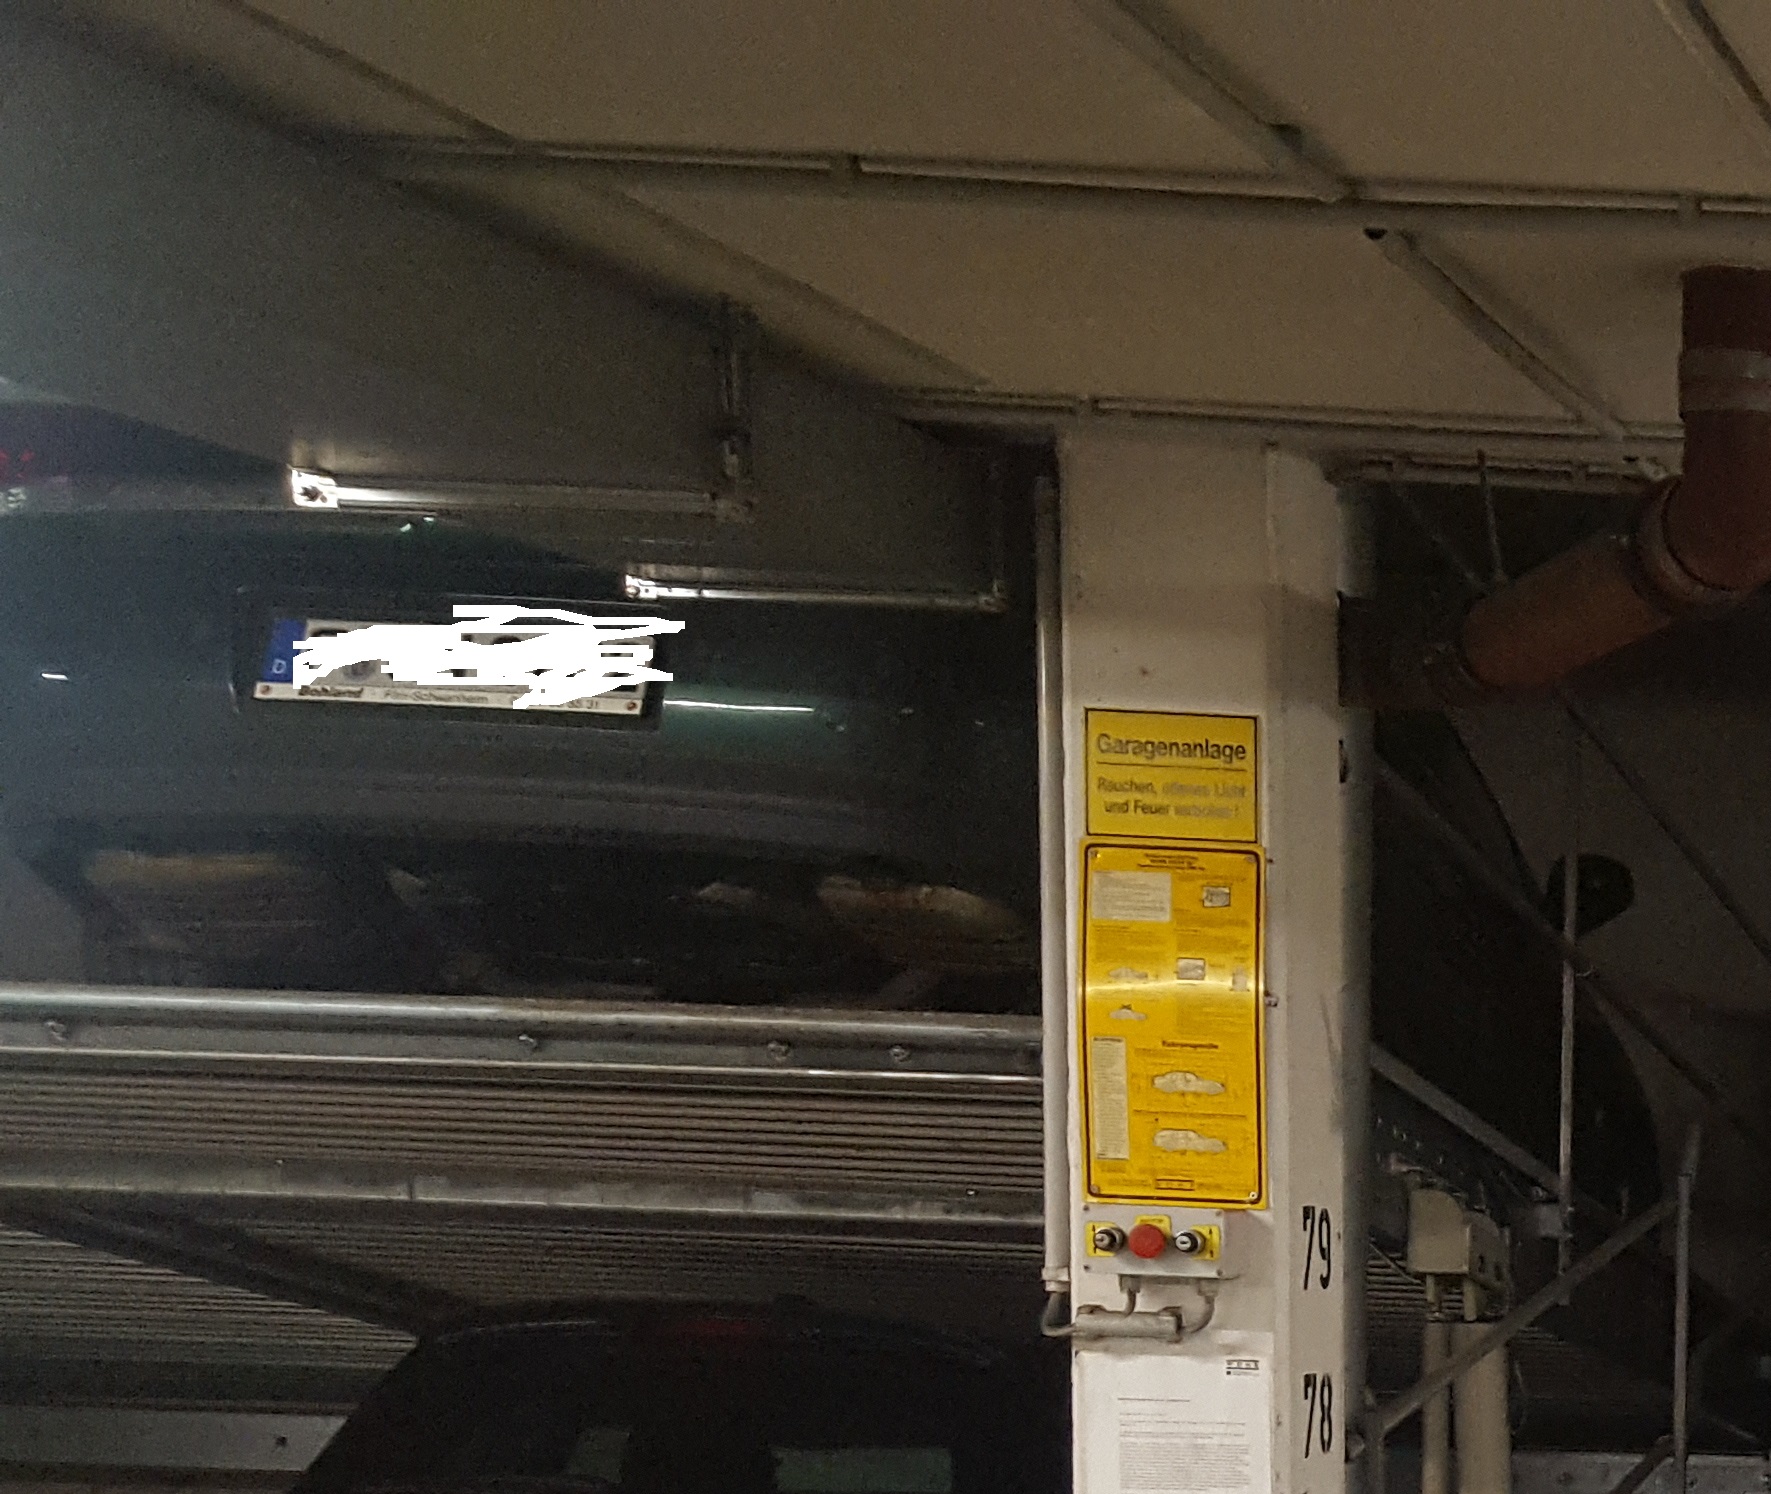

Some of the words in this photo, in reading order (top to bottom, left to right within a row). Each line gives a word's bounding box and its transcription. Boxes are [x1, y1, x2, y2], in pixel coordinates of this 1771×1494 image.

[1097, 733, 1247, 763] Garagenanlage
[1134, 801, 1170, 815] Feuer
[1302, 1205, 1331, 1290] 79
[1303, 1373, 1332, 1459] 78
